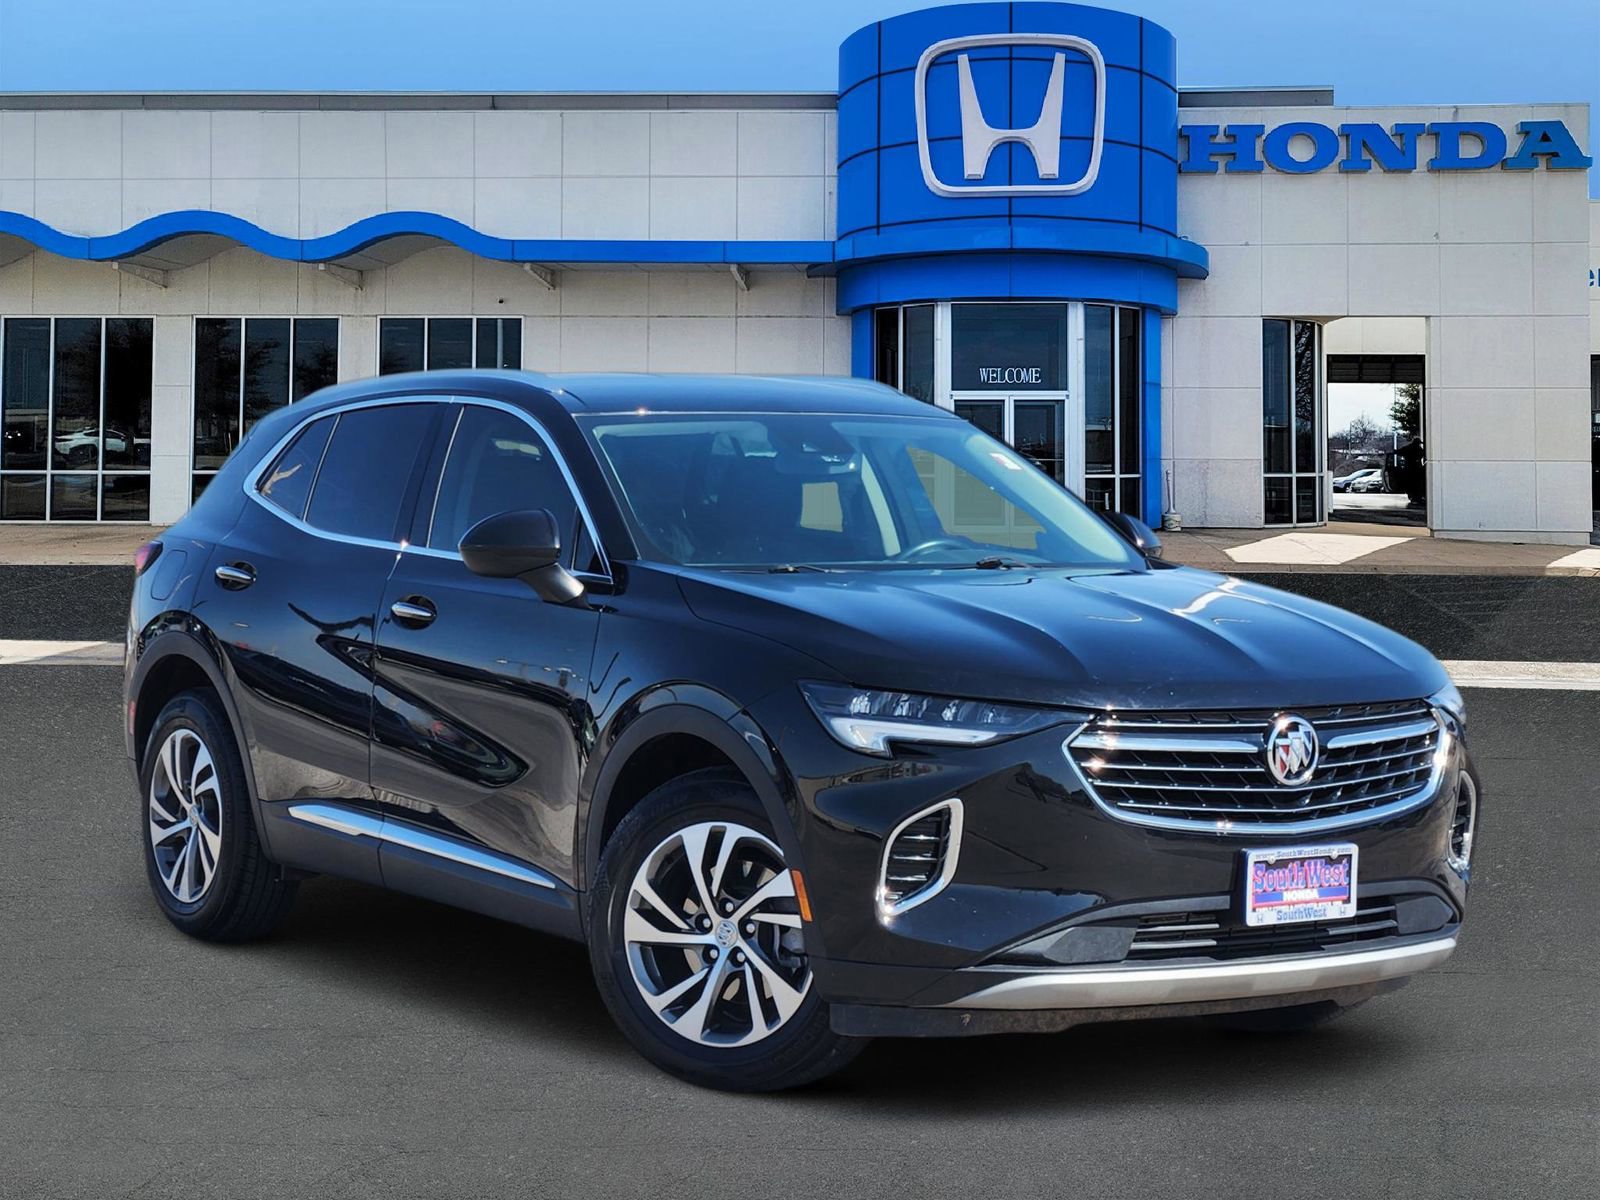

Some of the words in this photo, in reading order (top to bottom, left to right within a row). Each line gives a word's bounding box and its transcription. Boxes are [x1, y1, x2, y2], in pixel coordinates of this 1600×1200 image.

[1179, 119, 1593, 174] HONDA
[979, 367, 1042, 384] WELCOME
[1253, 858, 1350, 893] SouthWest
[1276, 905, 1328, 921] SouthWest
